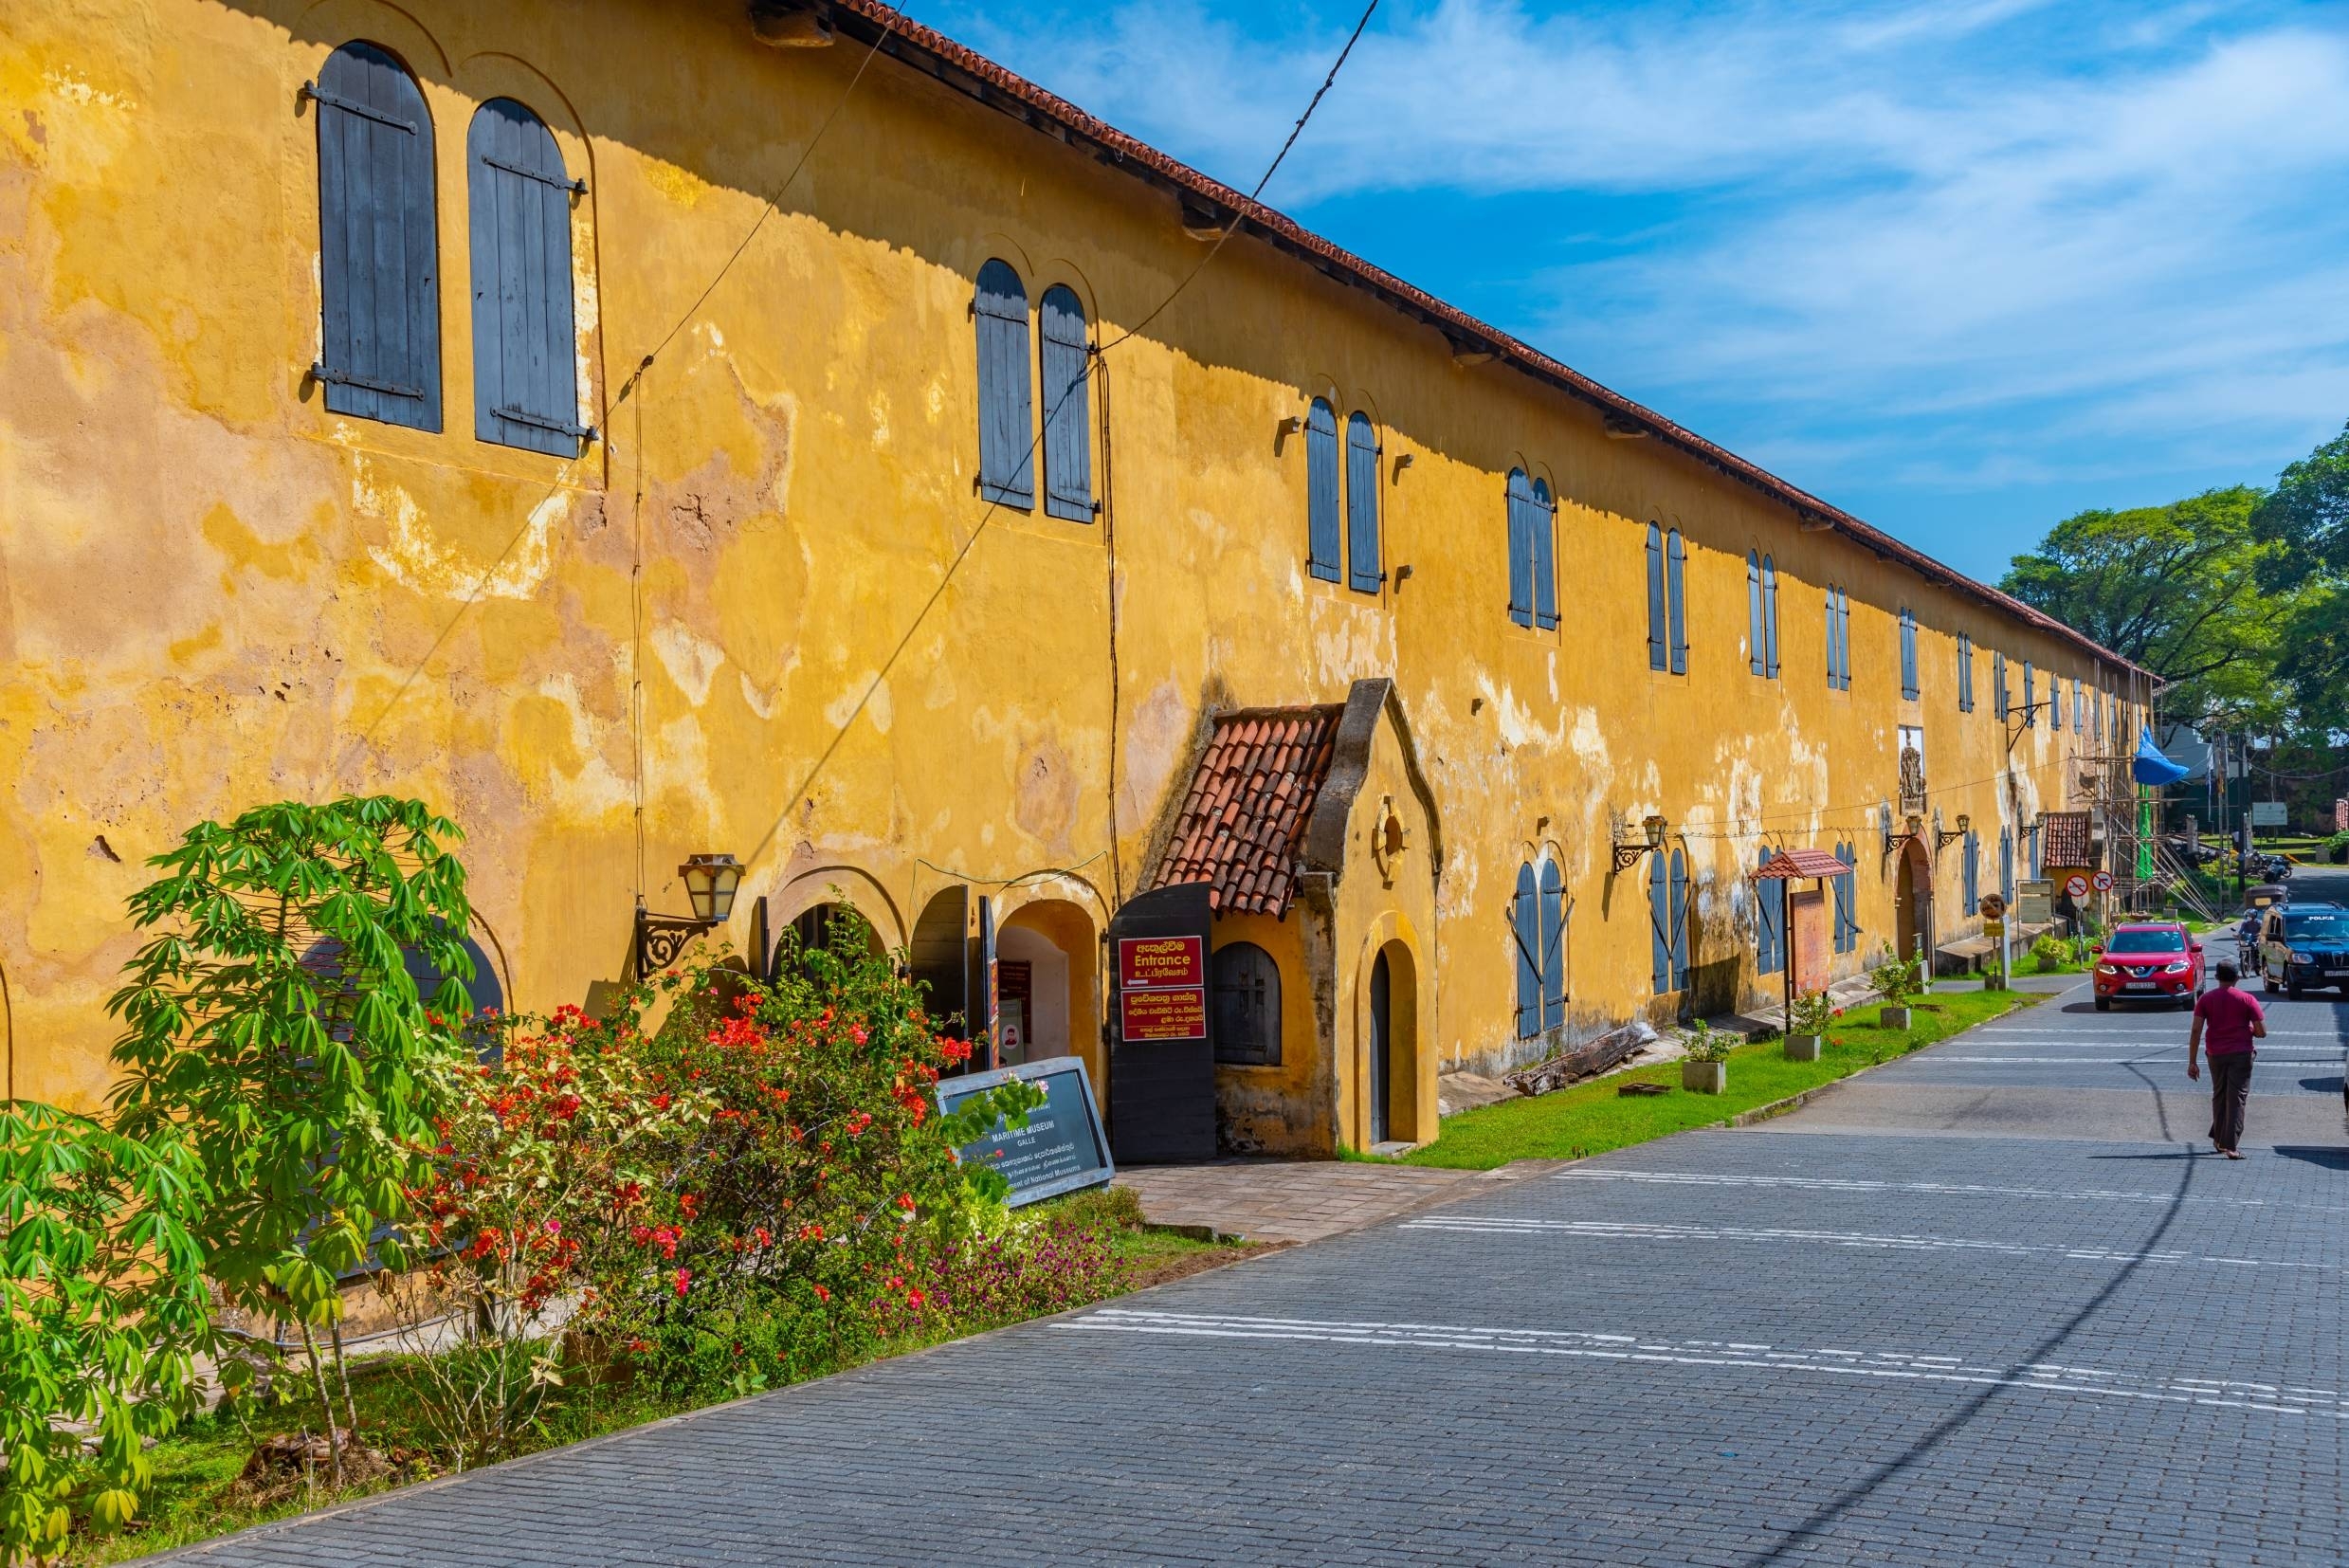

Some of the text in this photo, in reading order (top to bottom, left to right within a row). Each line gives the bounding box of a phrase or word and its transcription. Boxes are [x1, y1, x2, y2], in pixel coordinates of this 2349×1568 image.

[1135, 955, 1191, 966] Entrance
[992, 1120, 1055, 1143] MARITIME MUSEUM
[1017, 1137, 1036, 1147] GALLE
[1030, 1171, 1054, 1183] National
[1054, 1164, 1081, 1176] Museums
